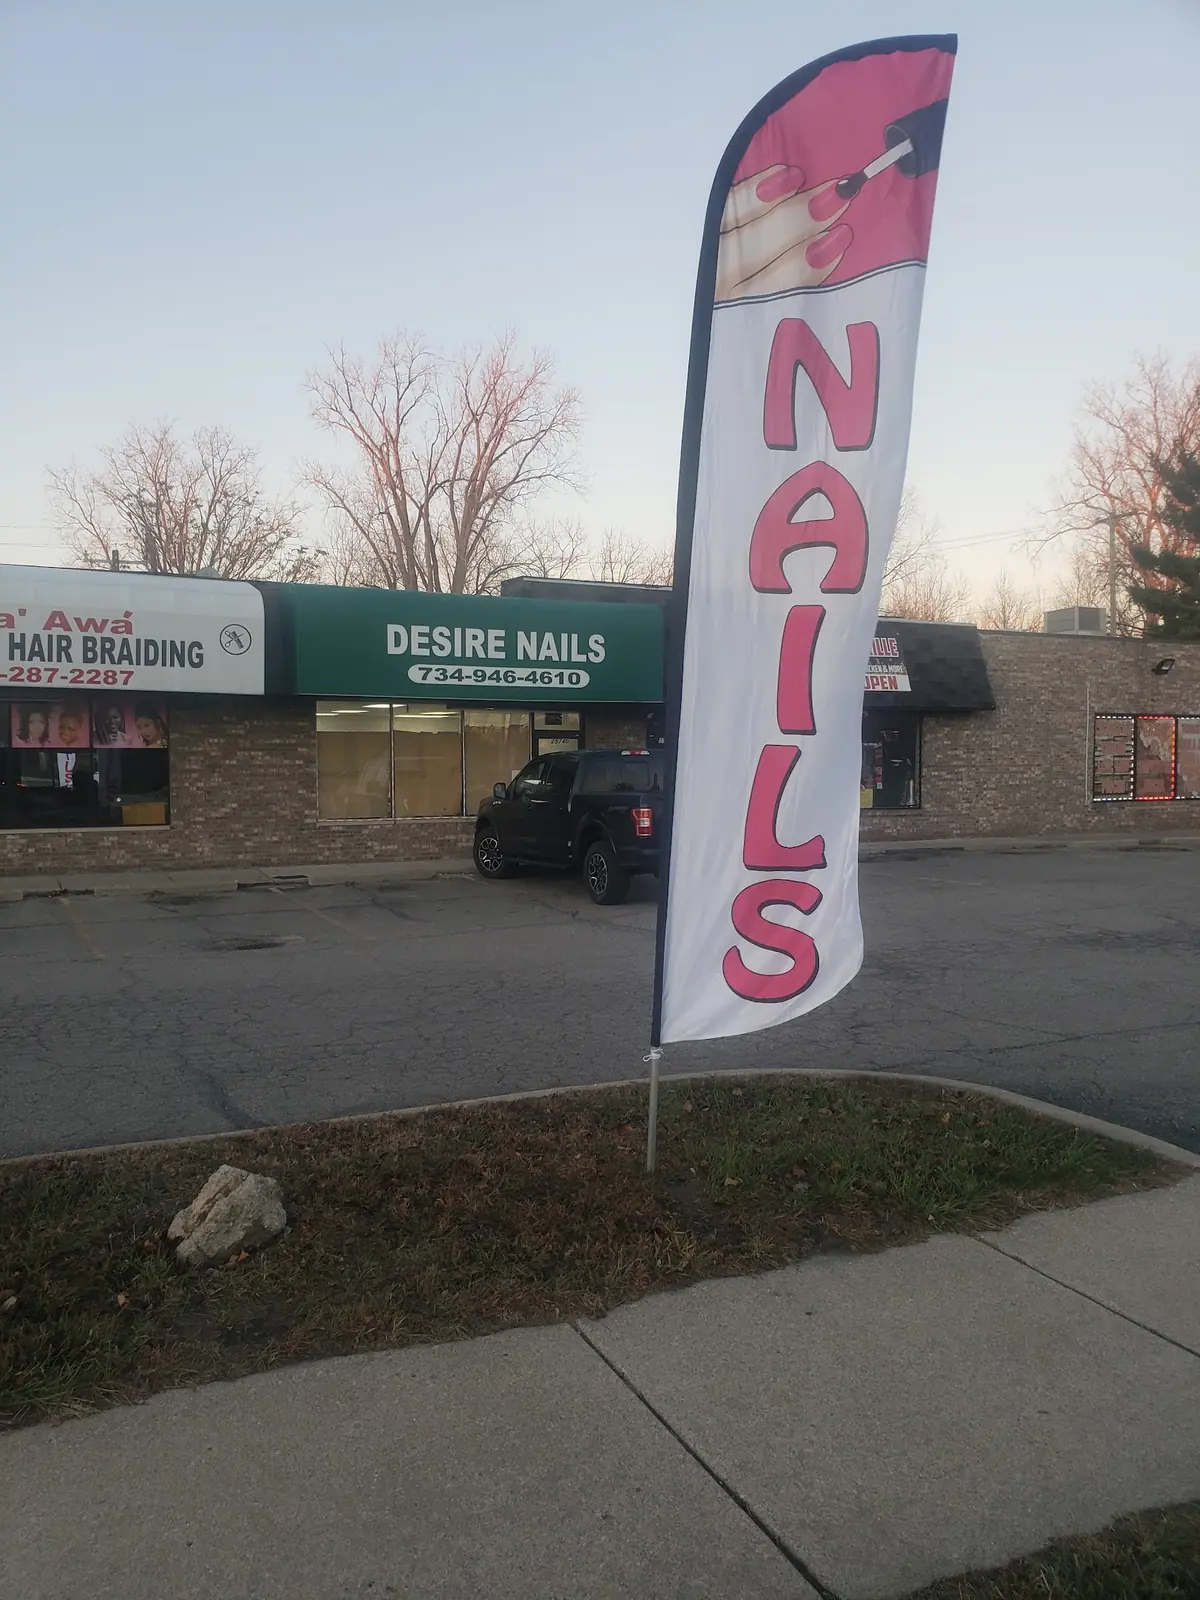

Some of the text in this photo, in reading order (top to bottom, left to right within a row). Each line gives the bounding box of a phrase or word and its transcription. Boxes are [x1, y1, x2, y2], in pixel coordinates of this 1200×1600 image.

[42, 610, 133, 635] Awá
[8, 632, 204, 668] HAIR BRAIDING
[387, 624, 606, 663] DESIRE NAILS
[722, 318, 879, 1003] NAILS
[418, 667, 581, 685] 734-946-4610
